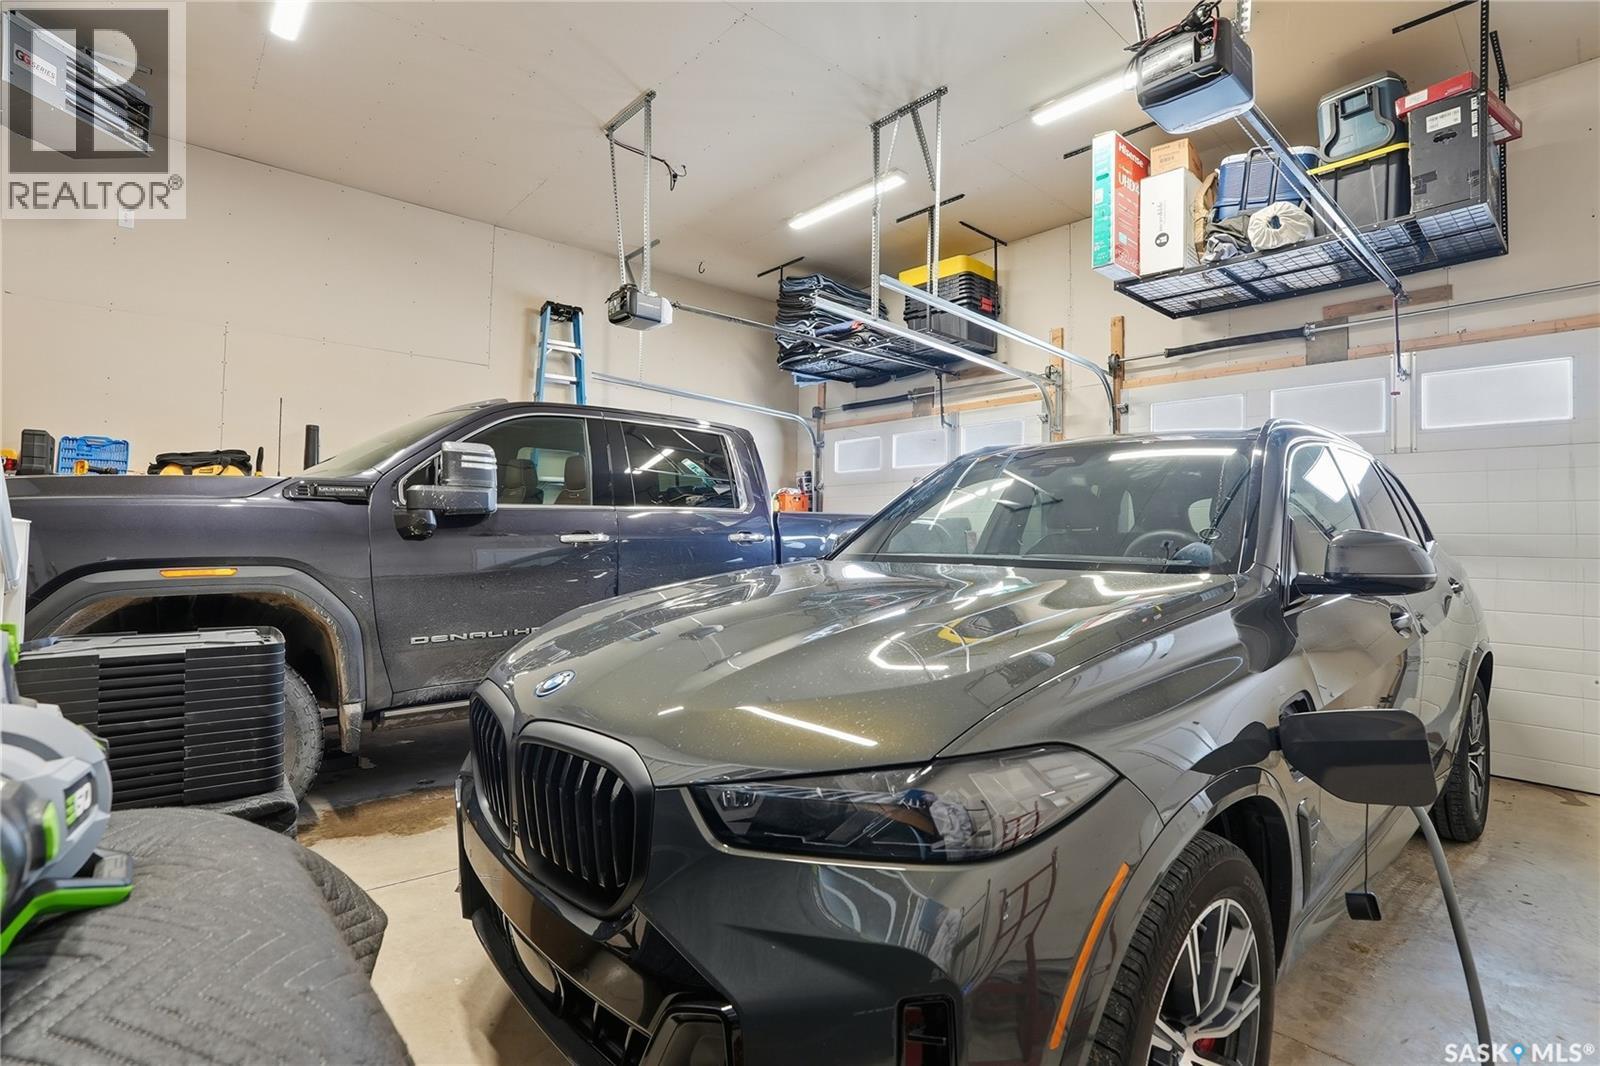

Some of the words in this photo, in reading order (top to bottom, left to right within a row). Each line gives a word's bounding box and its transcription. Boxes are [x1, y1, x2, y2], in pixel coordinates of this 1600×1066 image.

[32, 62, 56, 79] SERIES
[1118, 142, 1144, 168] Hisense
[410, 630, 508, 645] DENALI
